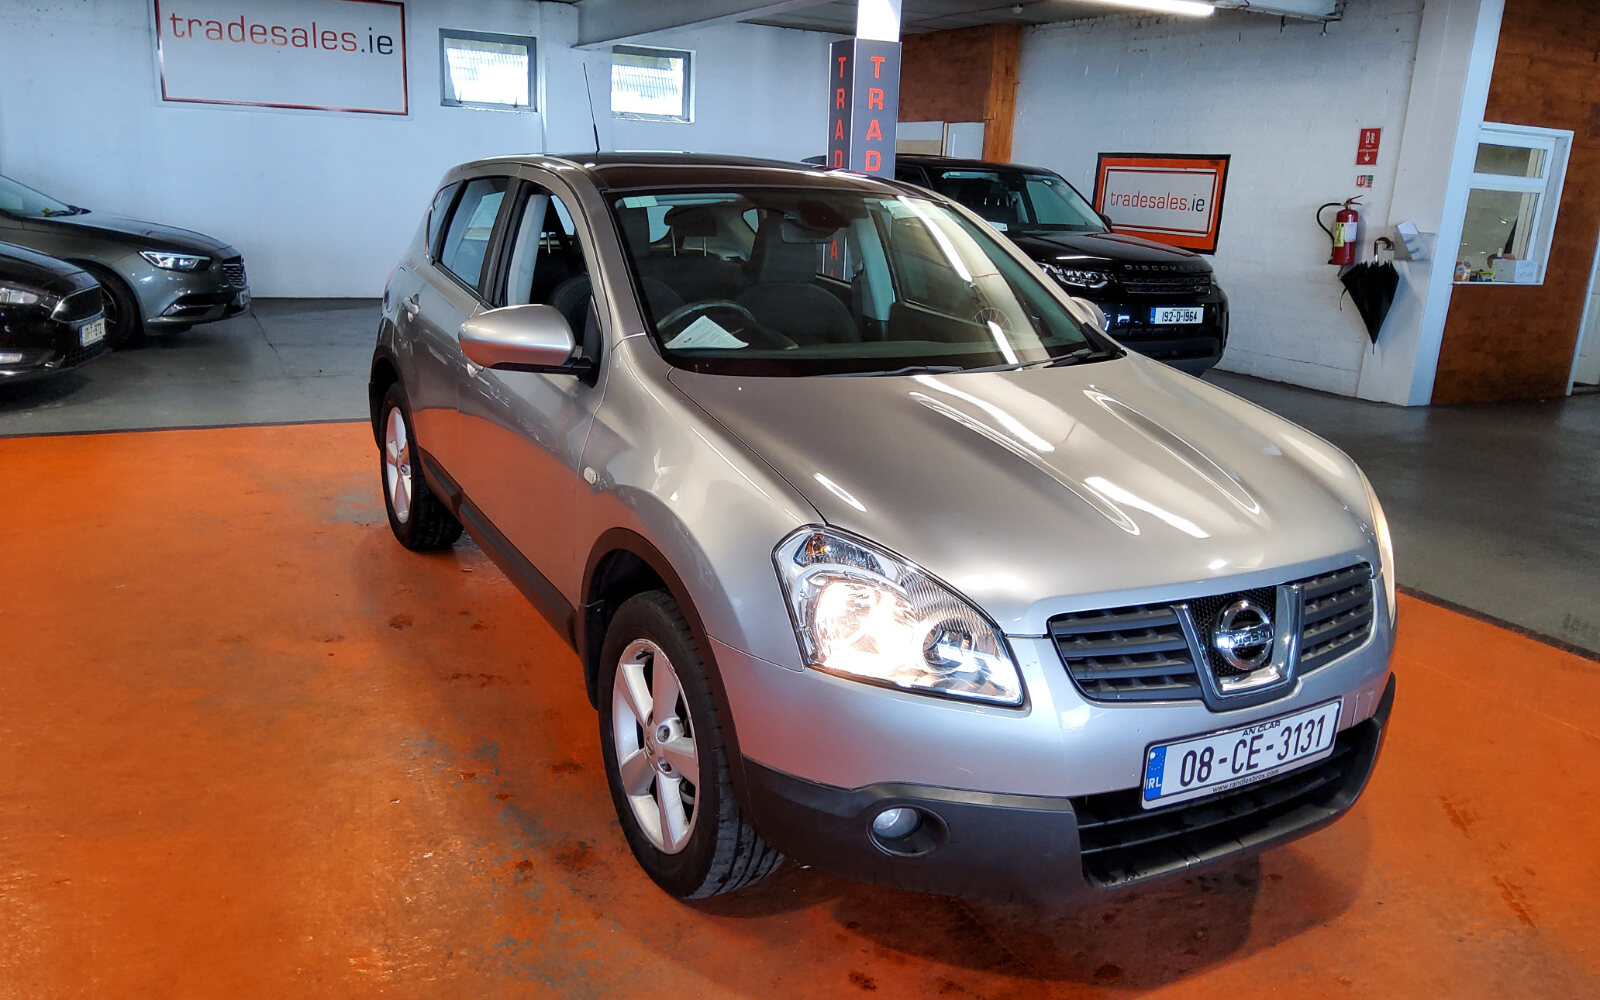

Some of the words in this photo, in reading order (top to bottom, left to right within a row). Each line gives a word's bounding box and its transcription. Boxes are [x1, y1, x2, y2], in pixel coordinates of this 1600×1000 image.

[169, 12, 393, 55] tradesales.ie
[1110, 190, 1205, 212] tradesales.ie
[1161, 311, 1198, 323] 192-D-1964
[1242, 728, 1256, 737] AN
[1180, 714, 1326, 787] 08-CE-3131
[1145, 776, 1162, 791] IRL
[1212, 769, 1280, 793] www.randlesbros.com
